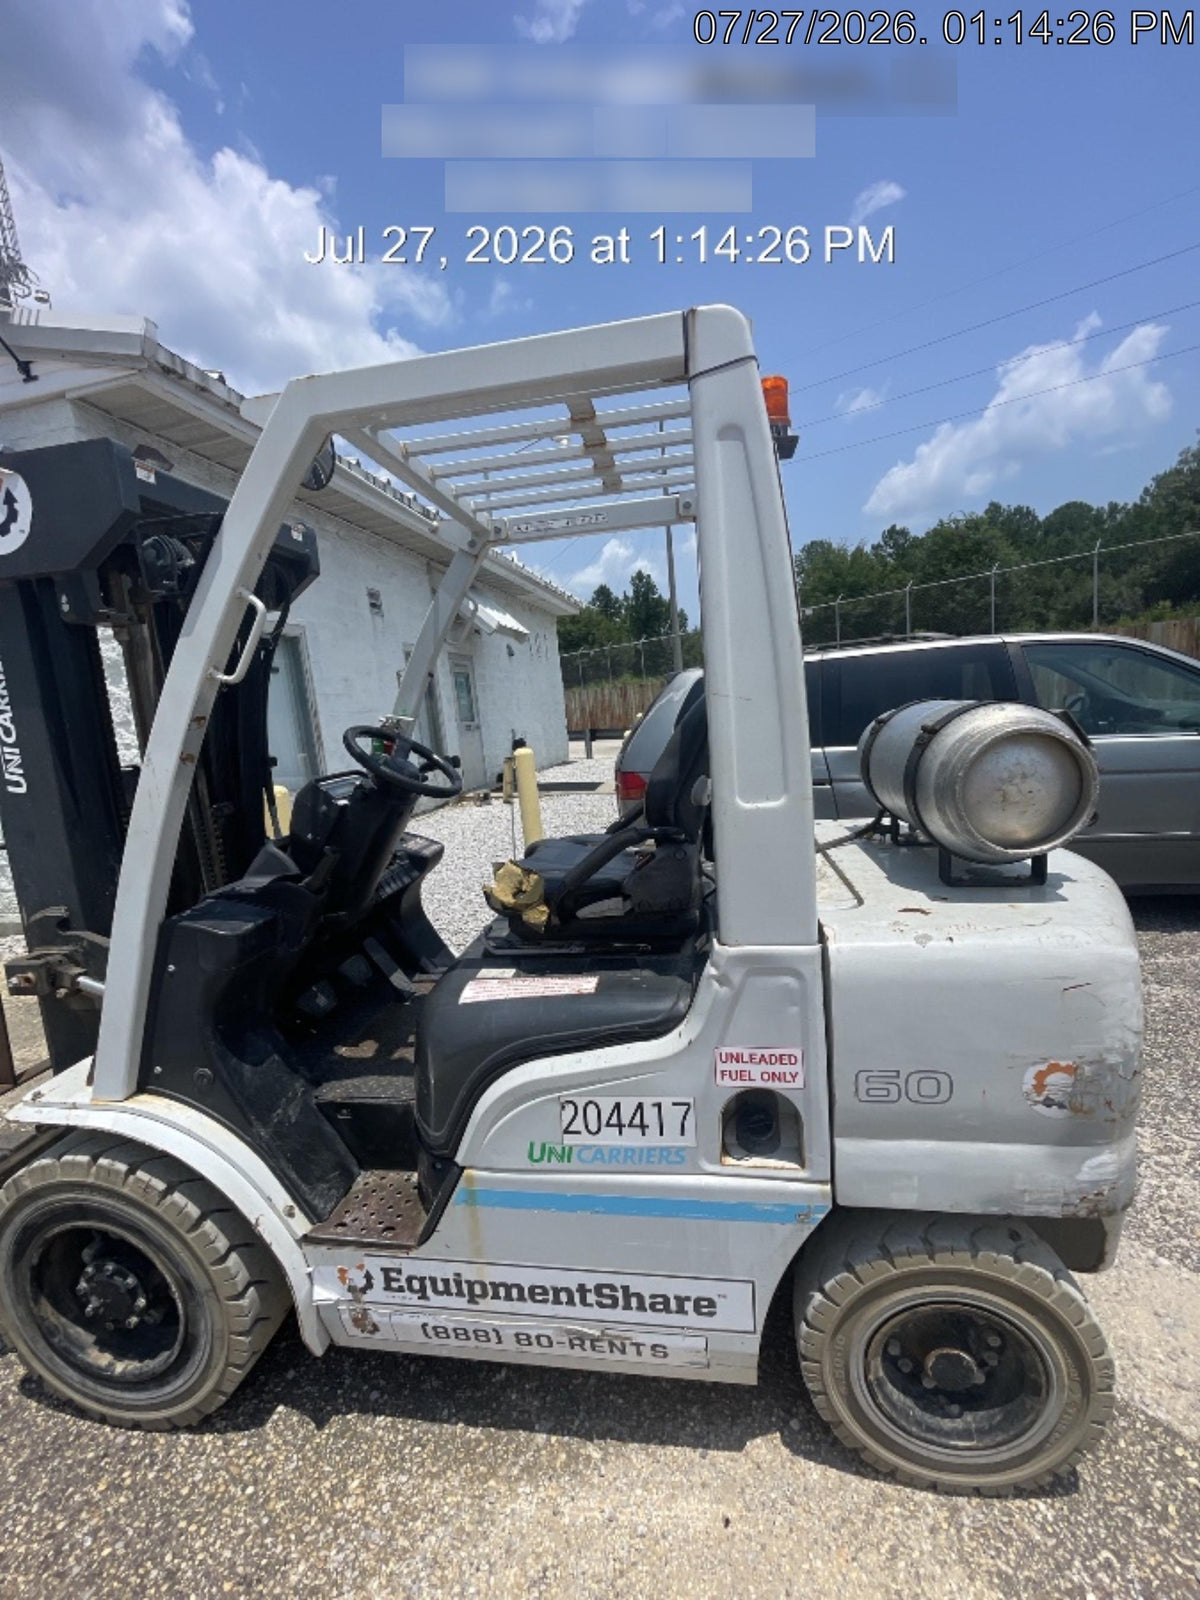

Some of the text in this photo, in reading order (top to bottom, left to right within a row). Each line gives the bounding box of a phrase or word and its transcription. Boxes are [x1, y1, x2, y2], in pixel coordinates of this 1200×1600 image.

[719, 1052, 798, 1066] UNLEADED
[720, 1069, 799, 1084] FUEL ONLY
[855, 1070, 953, 1104] 60
[562, 1099, 692, 1137] 204417
[421, 1321, 669, 1360] (888) 80-RENTS
